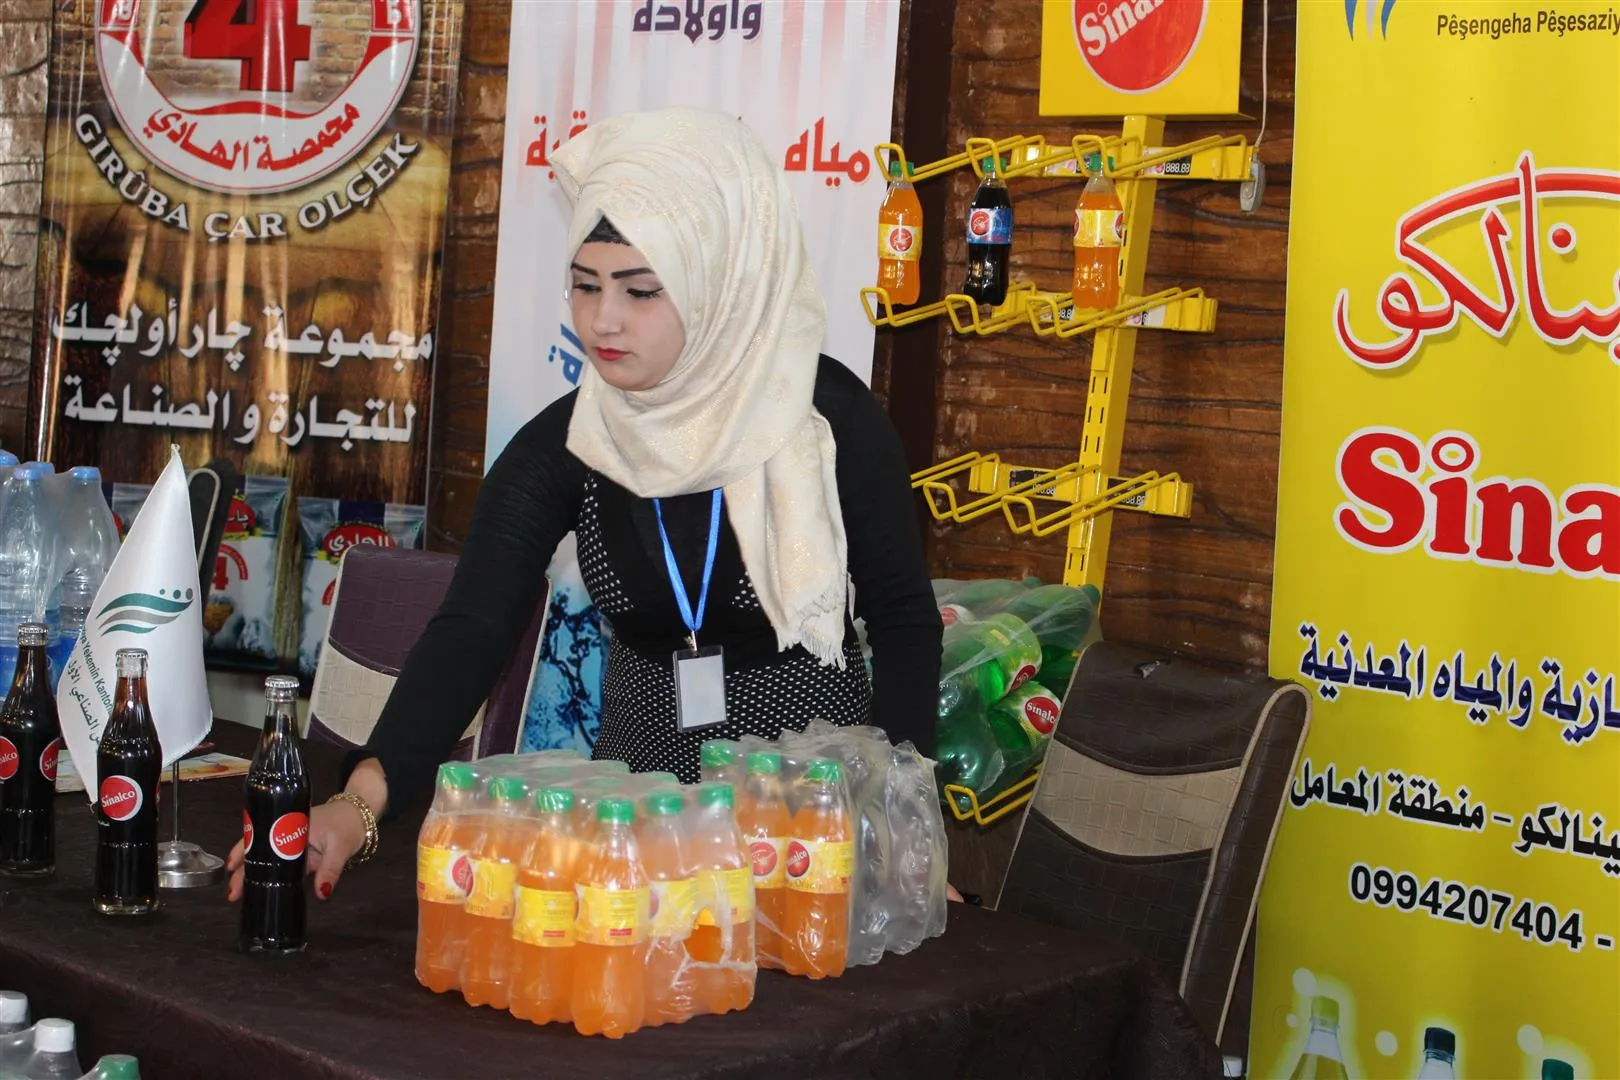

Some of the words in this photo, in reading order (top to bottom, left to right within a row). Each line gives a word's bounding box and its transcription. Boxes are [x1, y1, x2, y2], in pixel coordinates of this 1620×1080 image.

[1437, 13, 1531, 40] Pêşengeha
[143, 107, 250, 171] الهادي
[257, 103, 361, 172] محمصة
[784, 116, 872, 188] مياه
[75, 113, 189, 230] GIRÛBA
[204, 212, 287, 242] ÇAR
[298, 131, 419, 230] OLÇEK
[263, 304, 433, 371] مجموعة
[268, 391, 416, 451] للتجارة
[1298, 622, 1426, 700] المعدنية
[1431, 651, 1533, 728] والمياه
[1026, 701, 1056, 724] Sinalc
[1541, 658, 1620, 744] ازية
[101, 790, 136, 808] Sinalco
[1290, 761, 1379, 814] المعامل
[1387, 771, 1485, 830] منطقة
[1513, 805, 1620, 875] ينالكو
[1350, 864, 1583, 949] 0994207404
